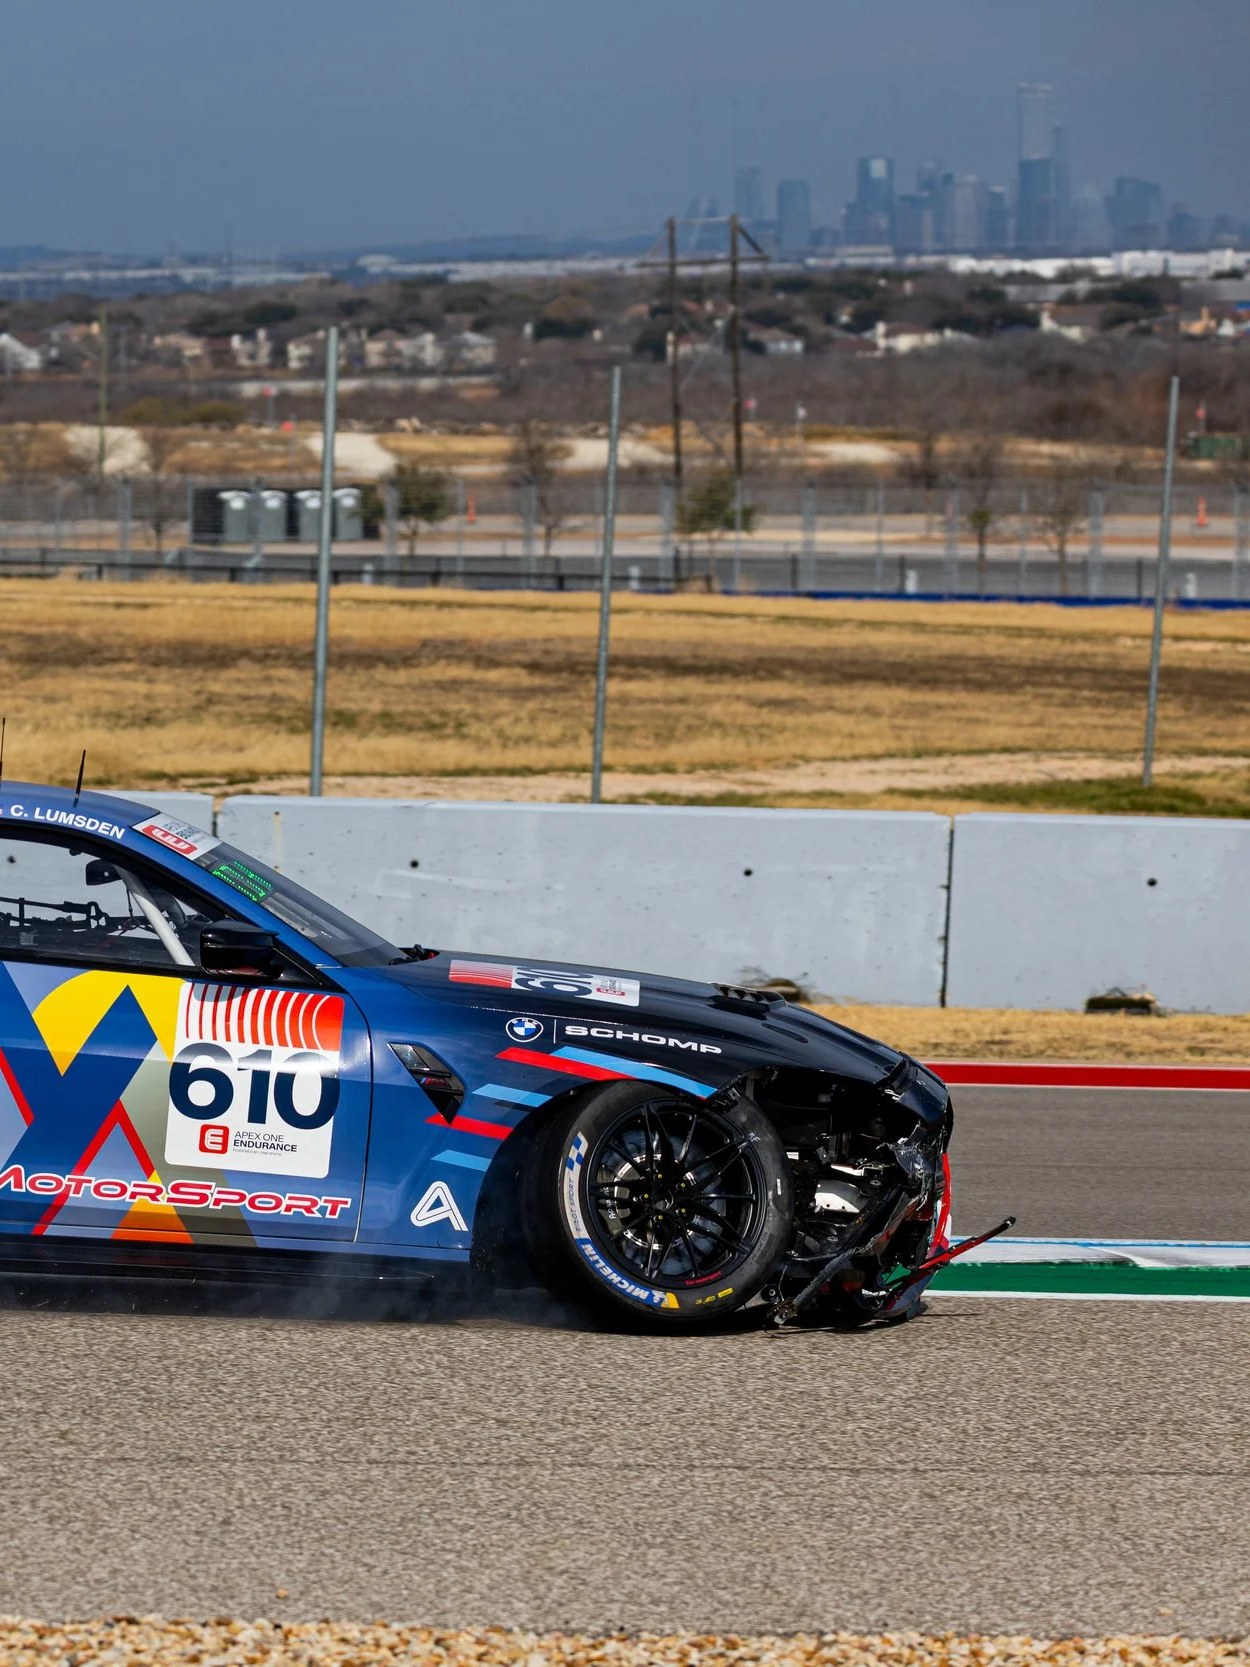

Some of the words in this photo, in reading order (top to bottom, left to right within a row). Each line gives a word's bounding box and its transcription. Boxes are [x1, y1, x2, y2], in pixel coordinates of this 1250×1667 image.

[10, 804, 28, 817] C.
[34, 807, 126, 839] LUMSDEN
[565, 1025, 722, 1054] SCHOMP
[169, 1042, 341, 1130] 610
[233, 1139, 297, 1152] ENDURANCE
[235, 1131, 262, 1141] APEX
[263, 1133, 284, 1143] ONE
[581, 1243, 649, 1301] MICHELIN
